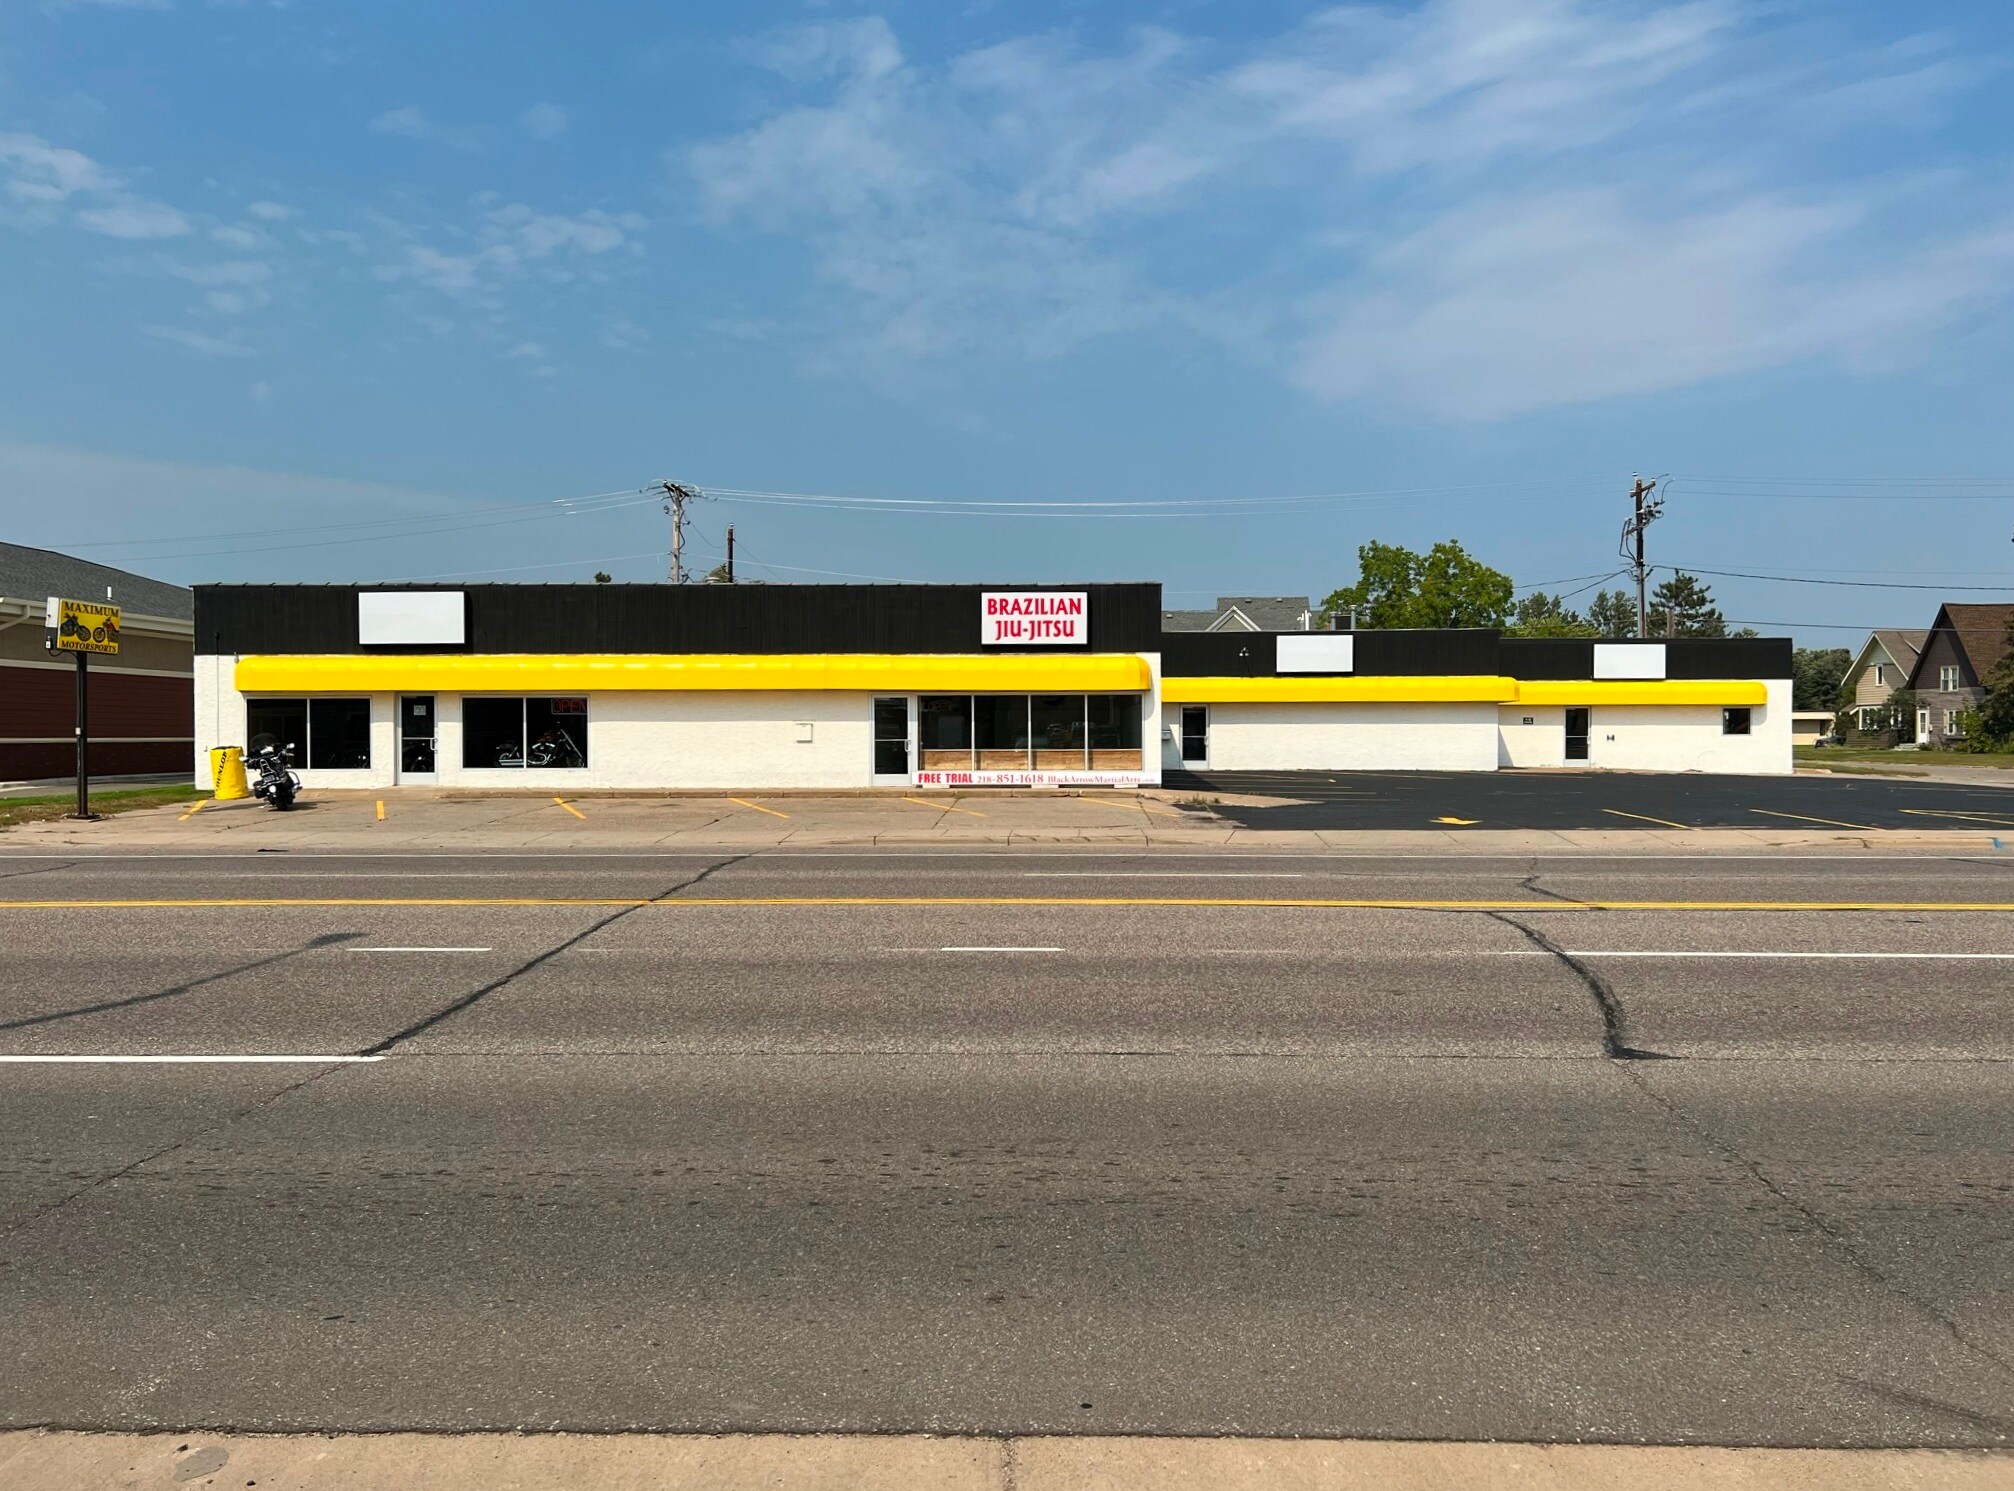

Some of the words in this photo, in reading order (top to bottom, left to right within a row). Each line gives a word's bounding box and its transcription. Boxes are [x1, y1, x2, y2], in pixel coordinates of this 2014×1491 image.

[64, 601, 119, 617] MAXIMUM
[987, 598, 1082, 615] BRAZILIAN
[995, 620, 1074, 640] JIU-JITSU
[61, 640, 117, 652] MOTORSPORTS
[553, 700, 587, 713] OPEN
[918, 773, 941, 783] FREE
[945, 773, 973, 783] TRIAL
[977, 774, 1044, 784] 218-851-1618
